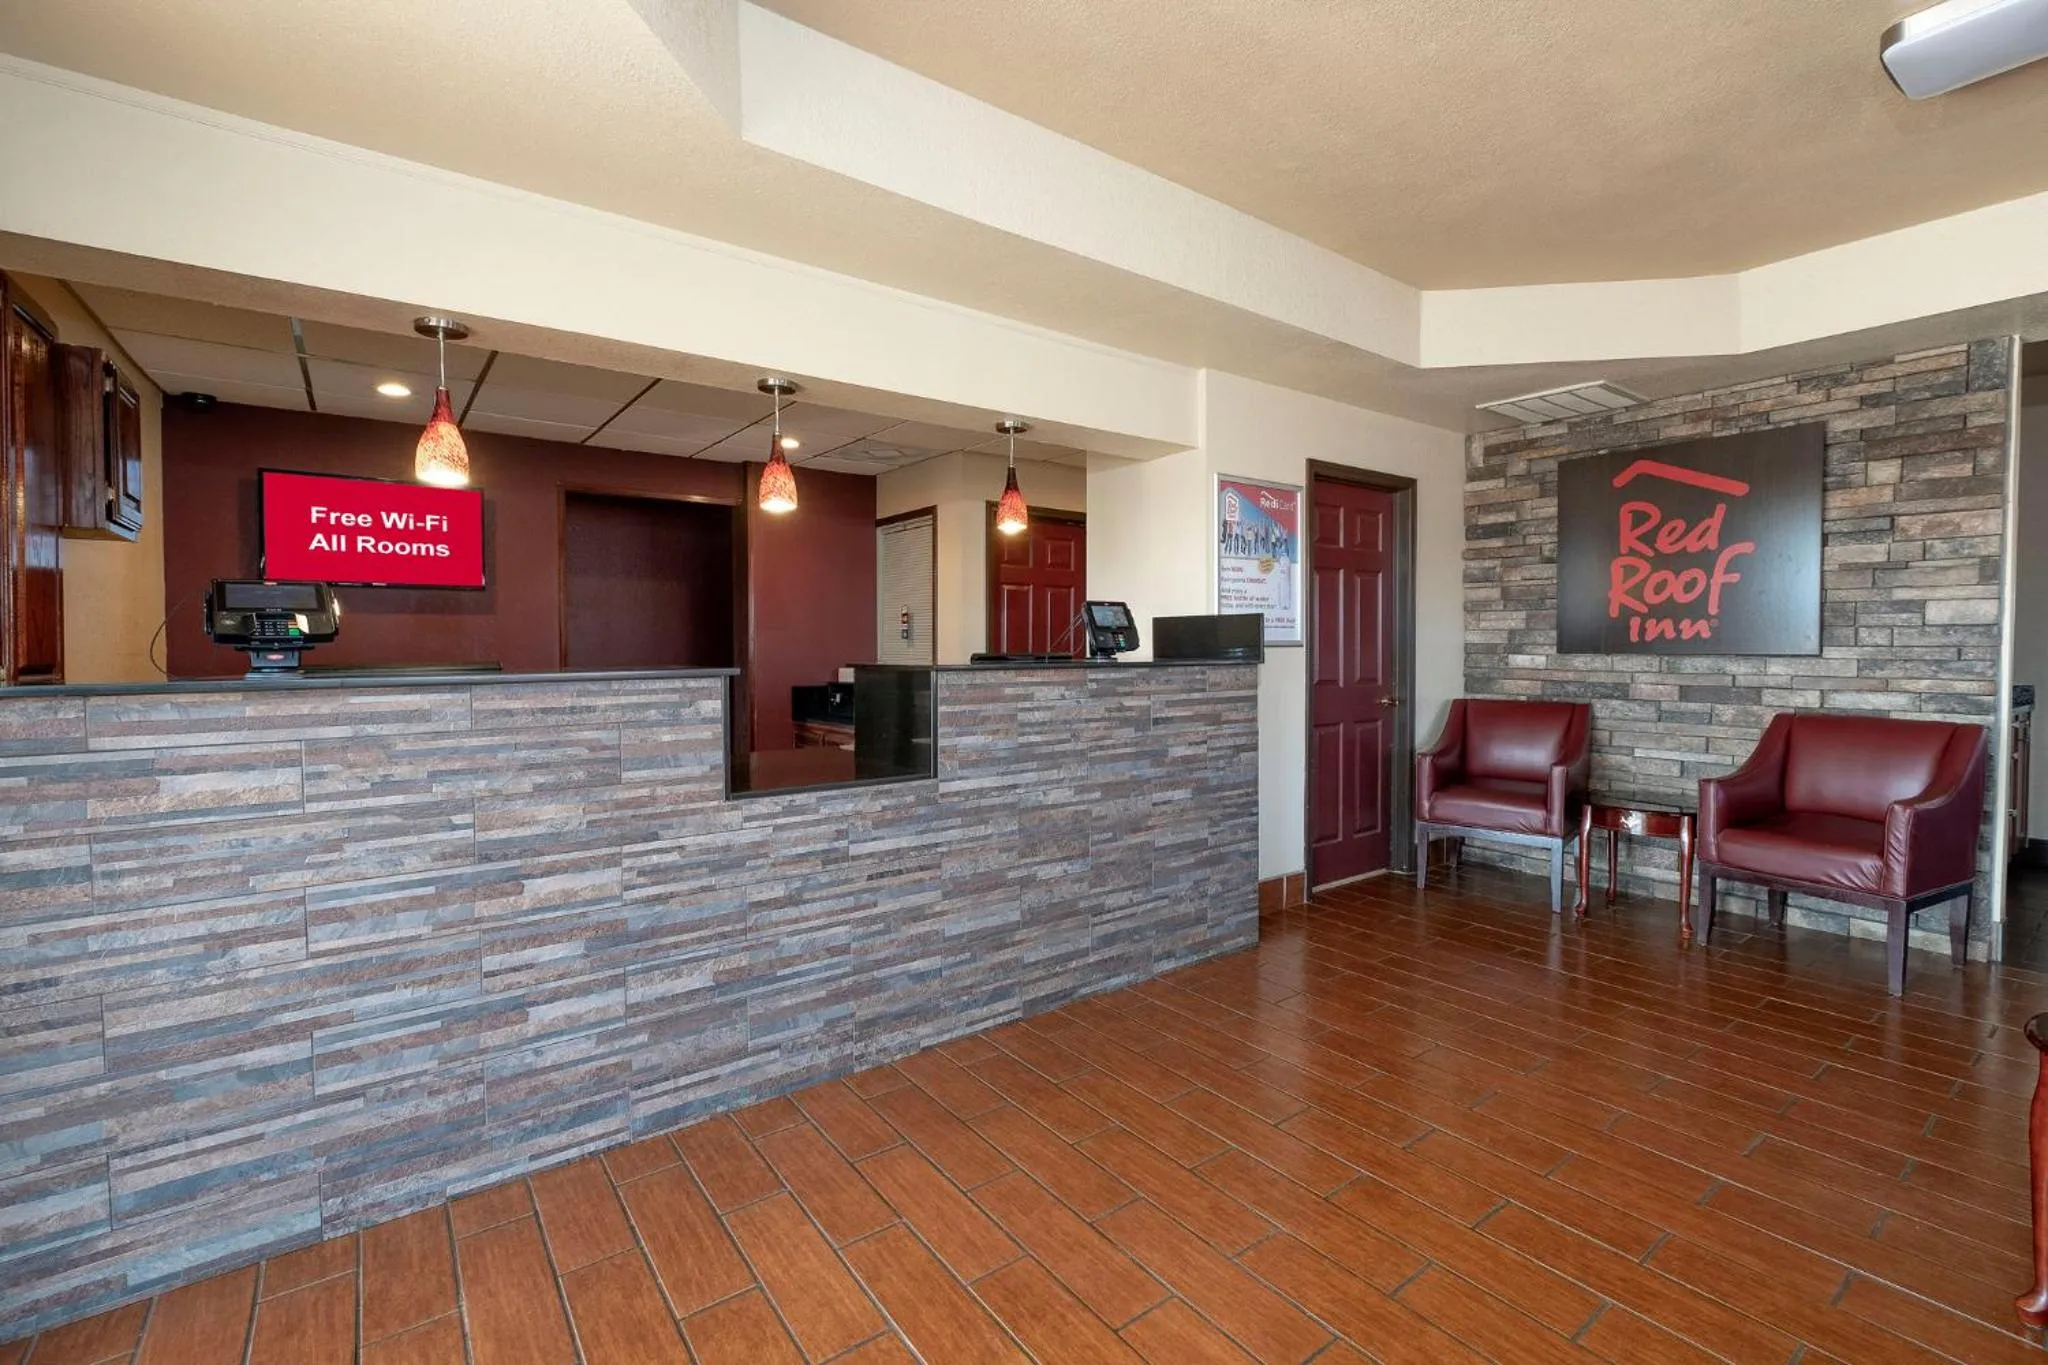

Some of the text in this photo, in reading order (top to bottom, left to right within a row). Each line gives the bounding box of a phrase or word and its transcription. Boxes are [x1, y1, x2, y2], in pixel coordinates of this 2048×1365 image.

[310, 506, 449, 533] Free Wi-Fi
[1619, 501, 1727, 557] Red
[308, 532, 451, 557] All Rooms
[1608, 541, 1755, 618] Roof
